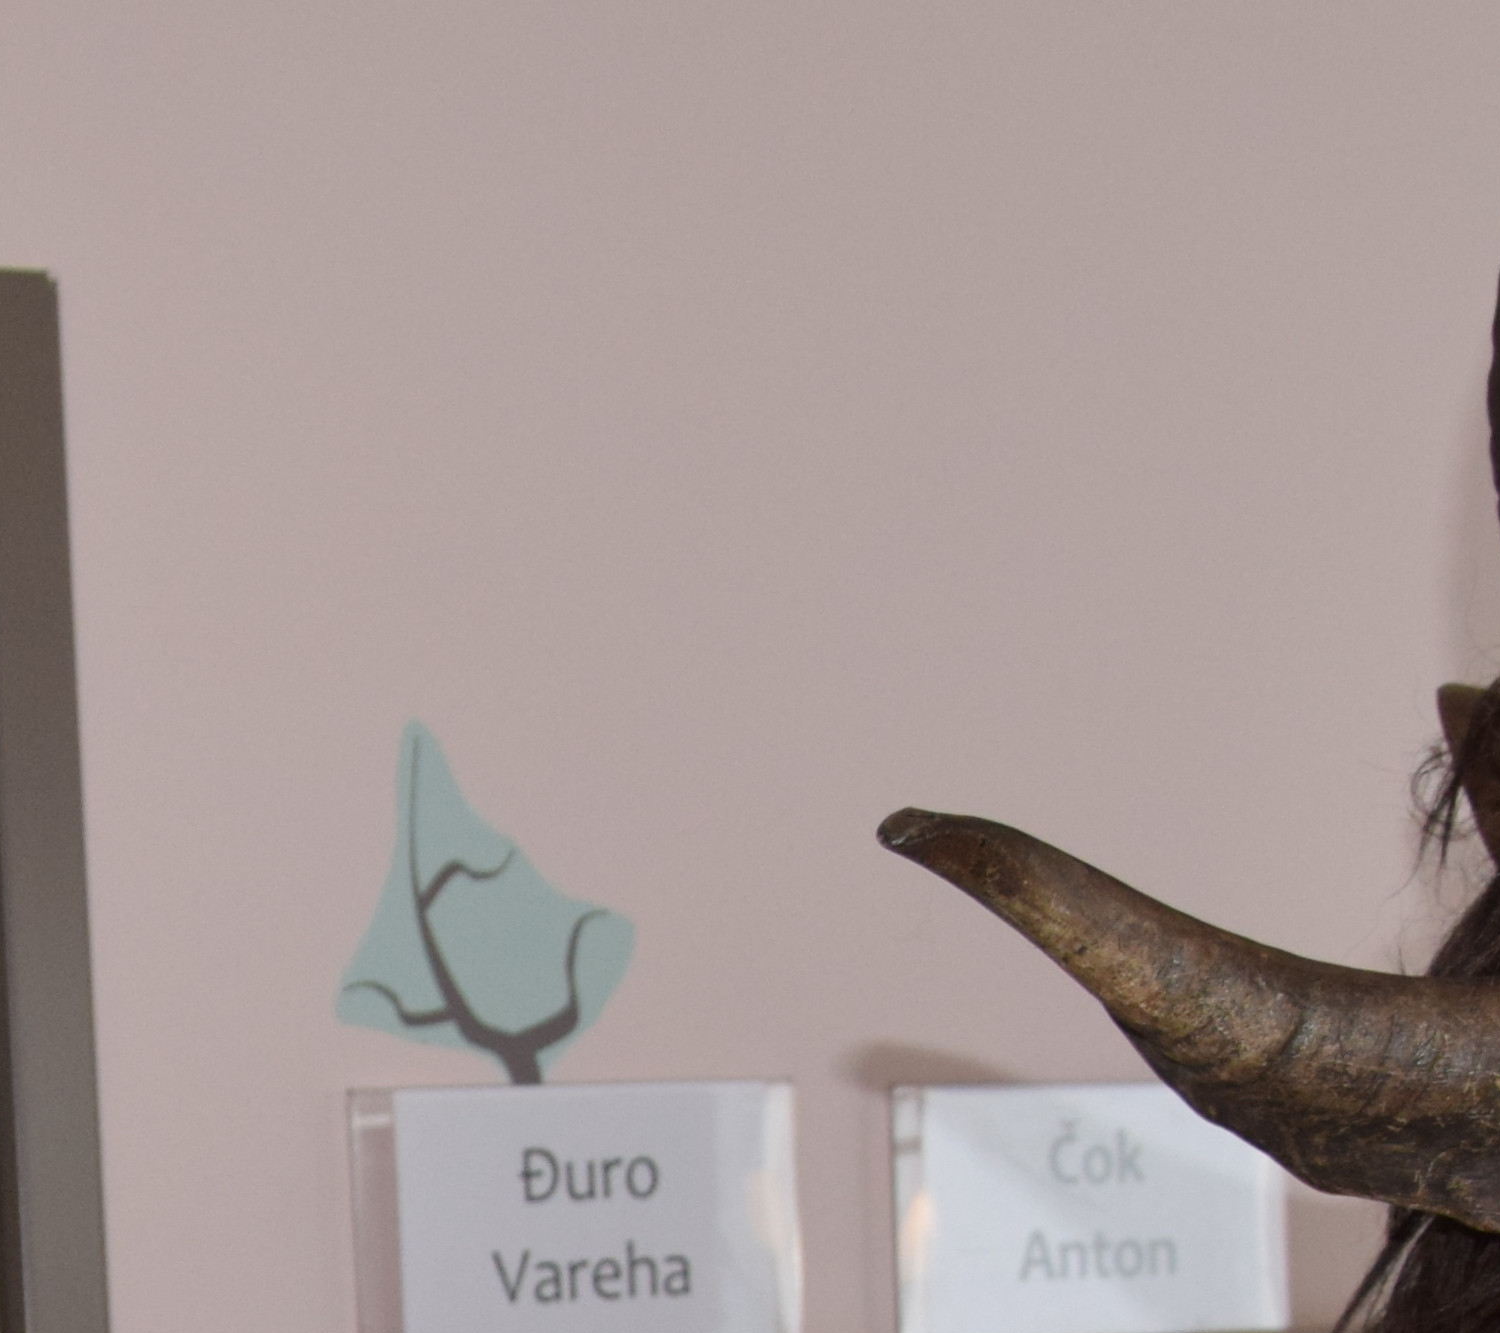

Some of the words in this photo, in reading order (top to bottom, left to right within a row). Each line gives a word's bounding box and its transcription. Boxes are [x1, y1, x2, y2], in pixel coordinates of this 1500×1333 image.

[518, 1147, 659, 1203] Đuro
[1048, 1120, 1146, 1186] Čok
[491, 1239, 692, 1304] Vareha
[1018, 1229, 1178, 1281] Anton
